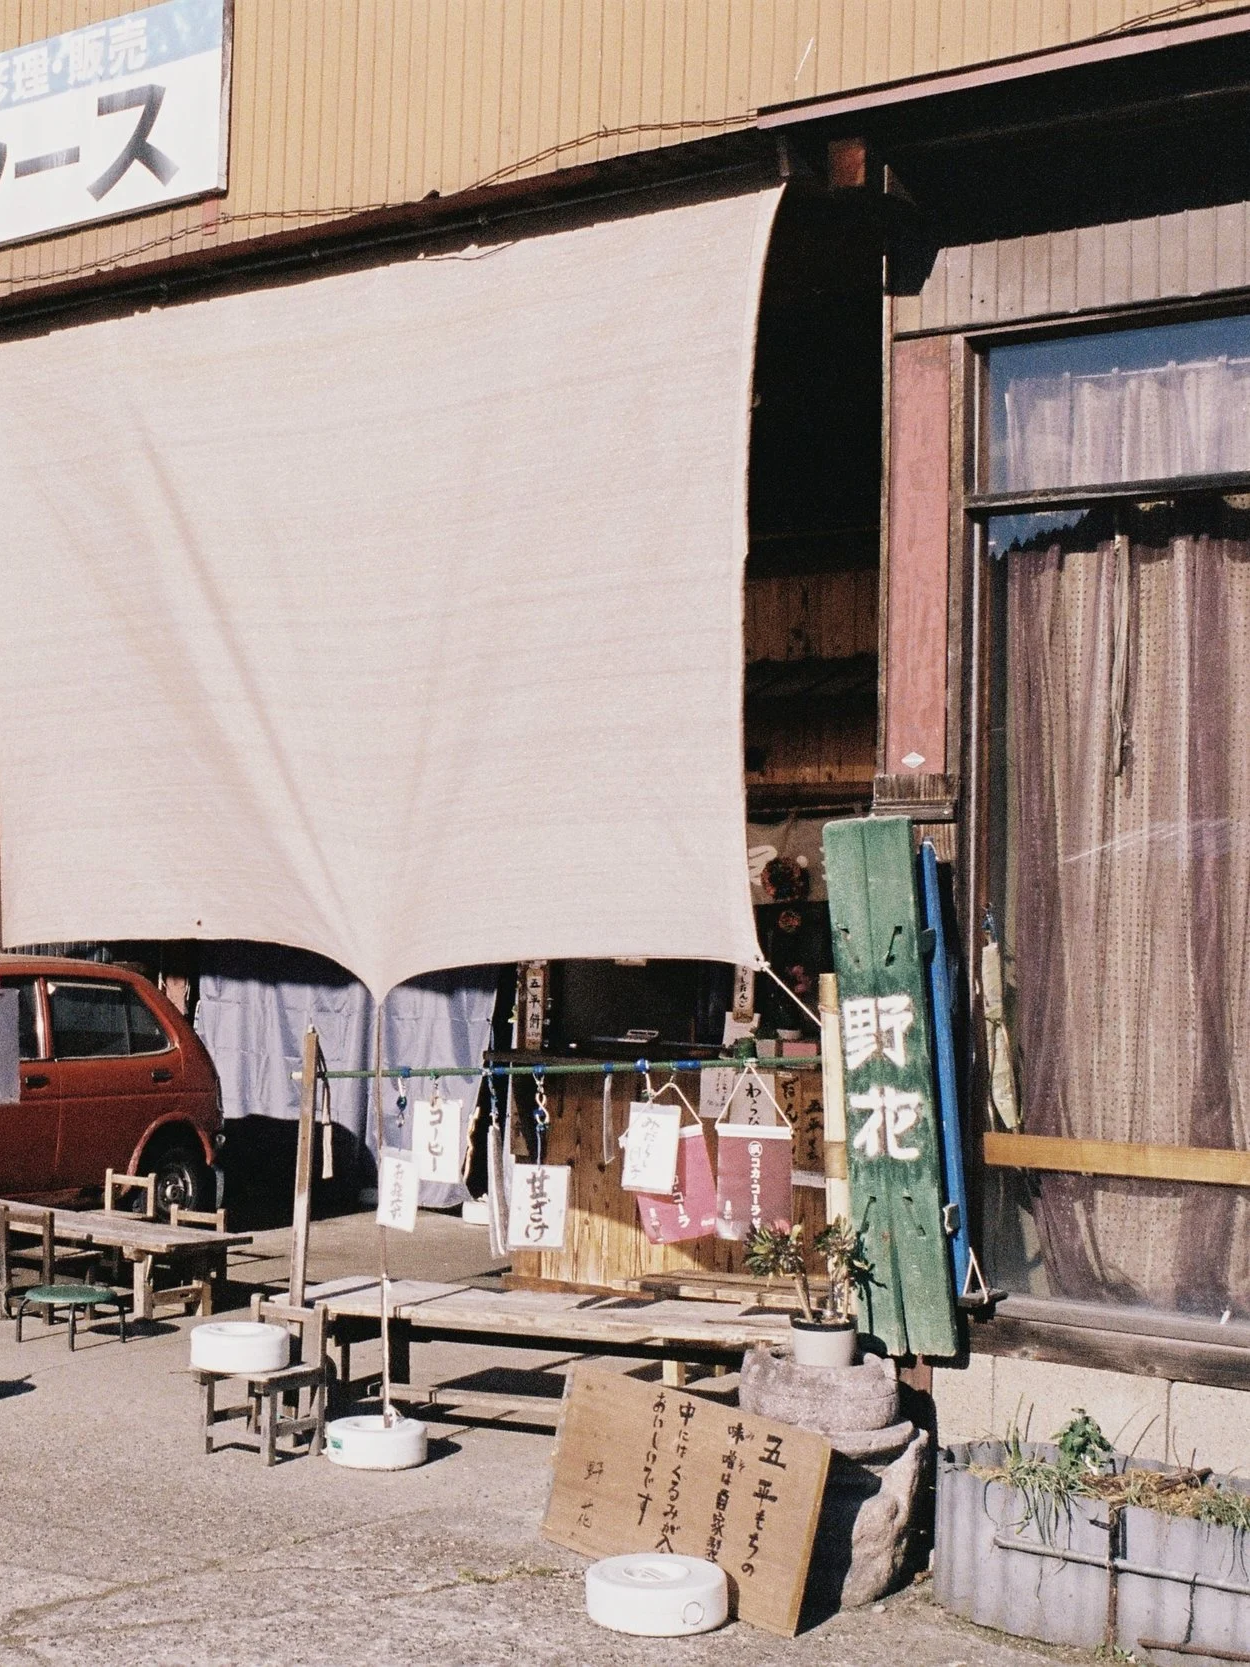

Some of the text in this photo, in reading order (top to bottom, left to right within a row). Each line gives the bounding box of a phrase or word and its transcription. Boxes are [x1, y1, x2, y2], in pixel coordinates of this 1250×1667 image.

[428, 1109, 444, 1172] コーヒー
[842, 993, 922, 1160] 野花
[525, 1170, 551, 1243] 甘ざけ
[637, 1391, 667, 1526] おいしいです
[742, 1434, 786, 1577] 五平もちの
